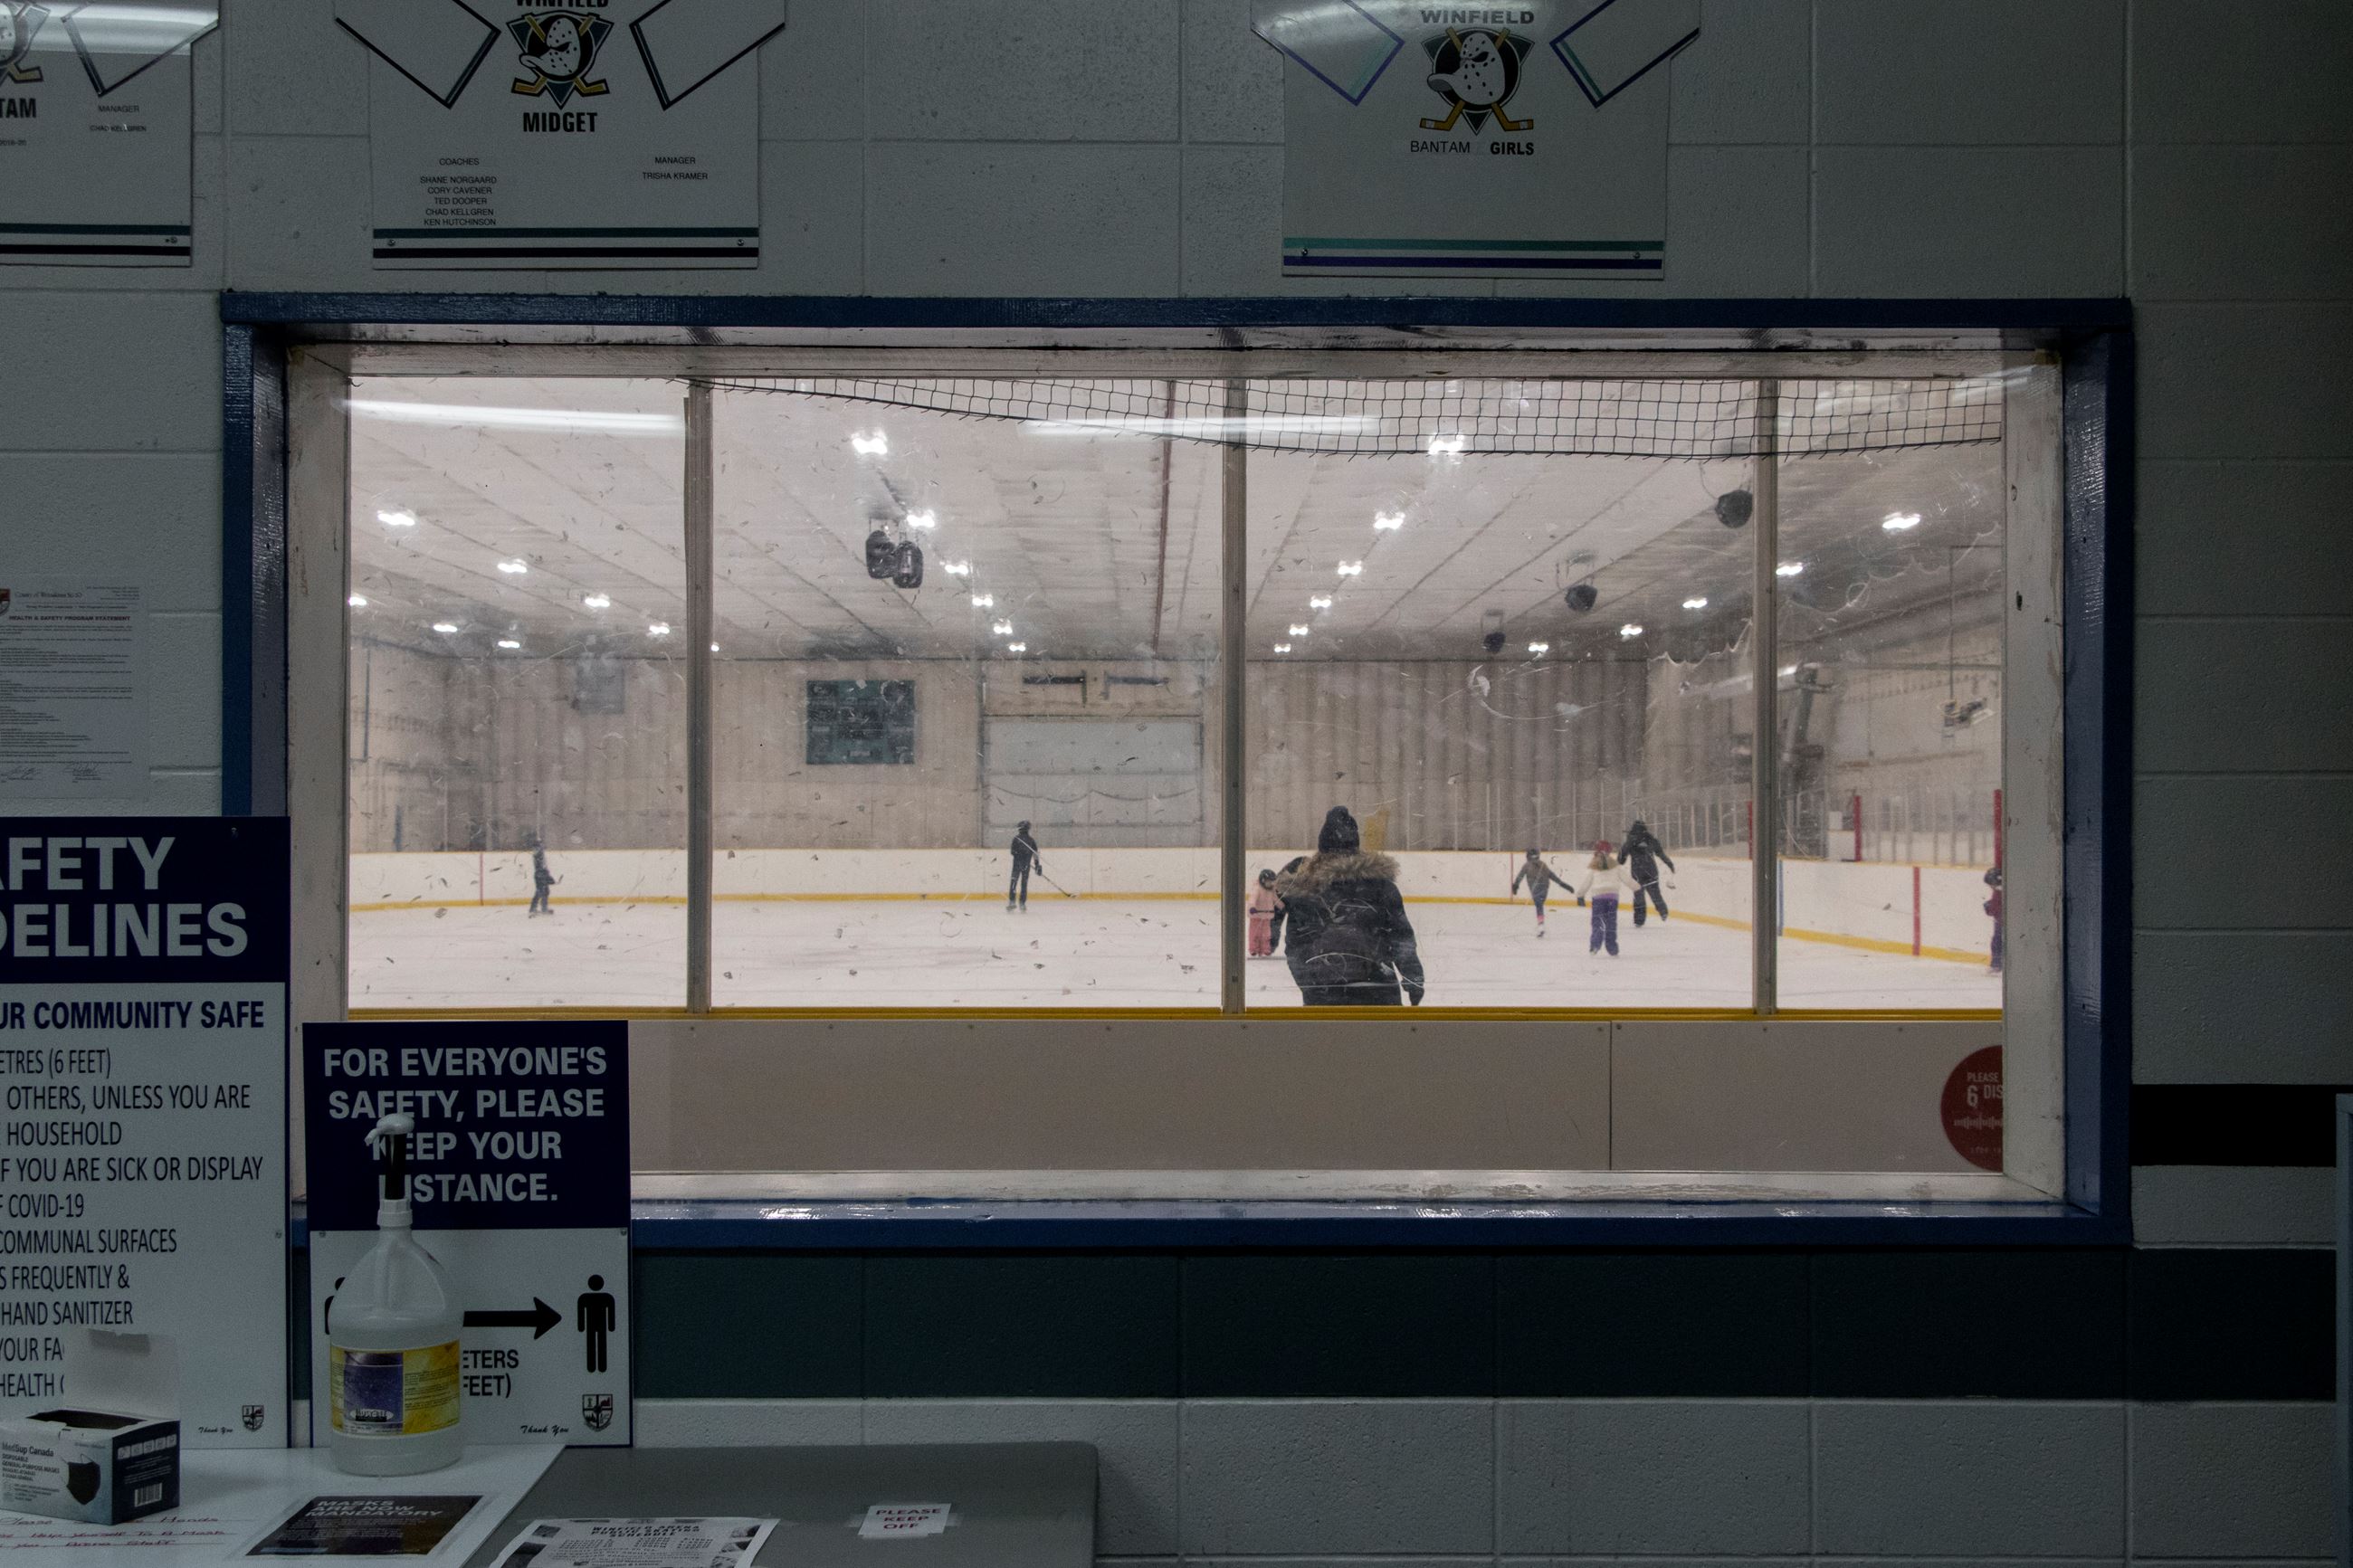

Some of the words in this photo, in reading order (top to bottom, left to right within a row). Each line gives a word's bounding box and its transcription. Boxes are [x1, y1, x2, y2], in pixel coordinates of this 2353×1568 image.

[1421, 10, 1535, 24] WINFIELD
[523, 112, 597, 132] MIDGET
[1410, 140, 1471, 153] BANTAM
[1490, 142, 1534, 155] GIRLS
[439, 157, 480, 166] COACHES
[420, 176, 448, 184] SHANE
[450, 176, 497, 184] NORGAARD
[643, 172, 672, 180] TRISHA
[673, 172, 708, 180] KRAMER
[427, 186, 450, 195] CORY
[452, 186, 492, 195] CAVENER
[425, 208, 449, 216] CHAD
[0, 836, 176, 890] FETY
[0, 902, 248, 957] ELINES
[33, 1002, 193, 1029] COMMUNITY
[200, 1001, 264, 1029] SAFE
[49, 1048, 64, 1079] (6
[69, 1048, 111, 1079] FEET)
[324, 1048, 389, 1077] FOR
[400, 1046, 607, 1077] EVERYONE'S
[1967, 1072, 1999, 1082] PLEASE
[7, 1086, 86, 1115] OTHERS,
[92, 1085, 163, 1109] UNLESS
[168, 1085, 208, 1108] YOU
[214, 1085, 251, 1108] ARE
[329, 1090, 465, 1123] SAFETY,
[477, 1088, 605, 1118] PLEASE
[1967, 1085, 1978, 1107] 6
[7, 1121, 122, 1146] HOUSEHOLD
[467, 1131, 562, 1160] YOUR
[16, 1158, 57, 1182] YOU
[63, 1157, 100, 1181] ARE
[107, 1156, 148, 1181] SICK
[154, 1156, 181, 1181] OR
[187, 1156, 263, 1180] DISPLAY
[8, 1193, 84, 1218] COVID-19
[99, 1229, 177, 1253] SURFACES
[12, 1265, 113, 1292] FREQUENTLY
[118, 1264, 130, 1289] &
[1, 1301, 48, 1326] HAND
[52, 1301, 133, 1325] SANITIZER
[44, 1337, 64, 1361] FA
[520, 1425, 548, 1433] Thank
[551, 1425, 569, 1436] You
[29, 1446, 54, 1457] Canada
